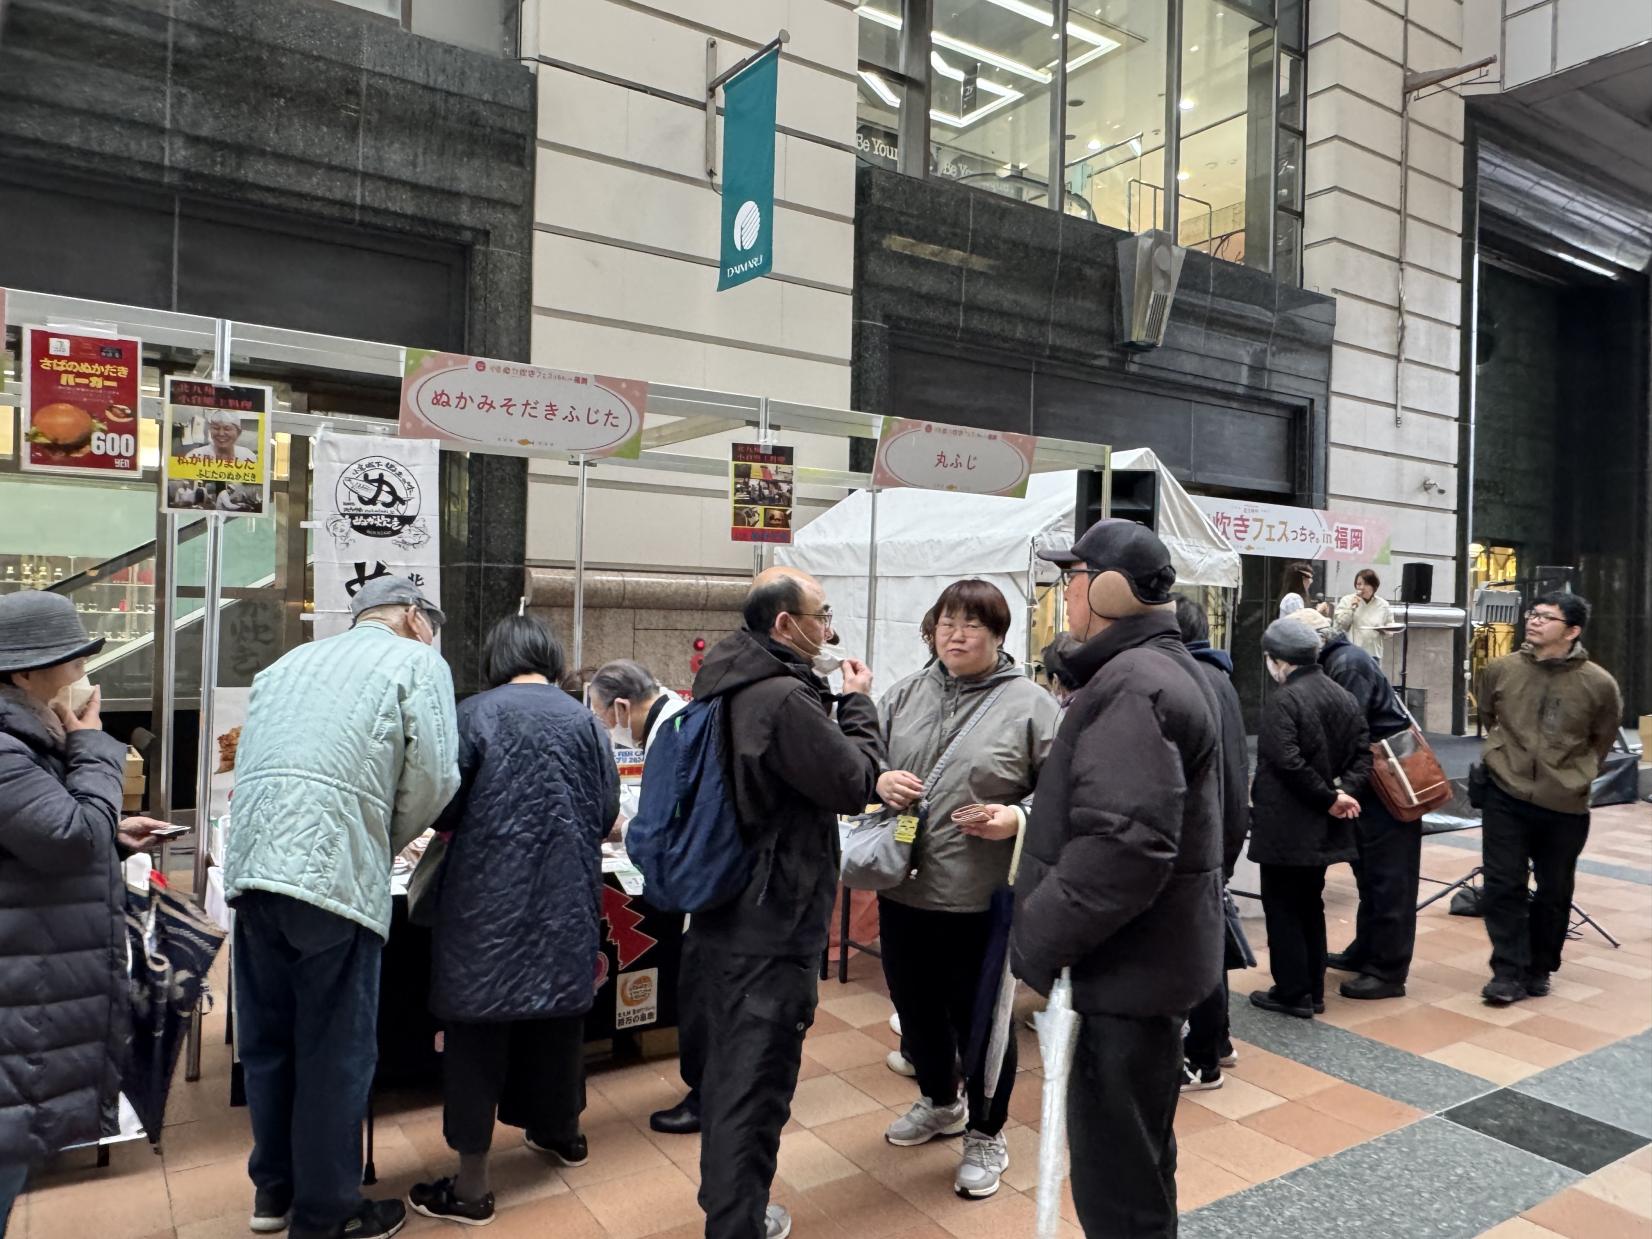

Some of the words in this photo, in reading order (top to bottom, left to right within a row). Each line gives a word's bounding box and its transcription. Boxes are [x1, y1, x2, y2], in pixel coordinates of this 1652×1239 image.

[39, 357, 128, 378] さばのぬかだき
[60, 373, 118, 389] バーガー
[431, 389, 619, 428] ぬかみそだきふじた
[91, 431, 134, 457] 600
[177, 454, 256, 470] 私が作りました
[934, 451, 977, 470] 丸ふじ
